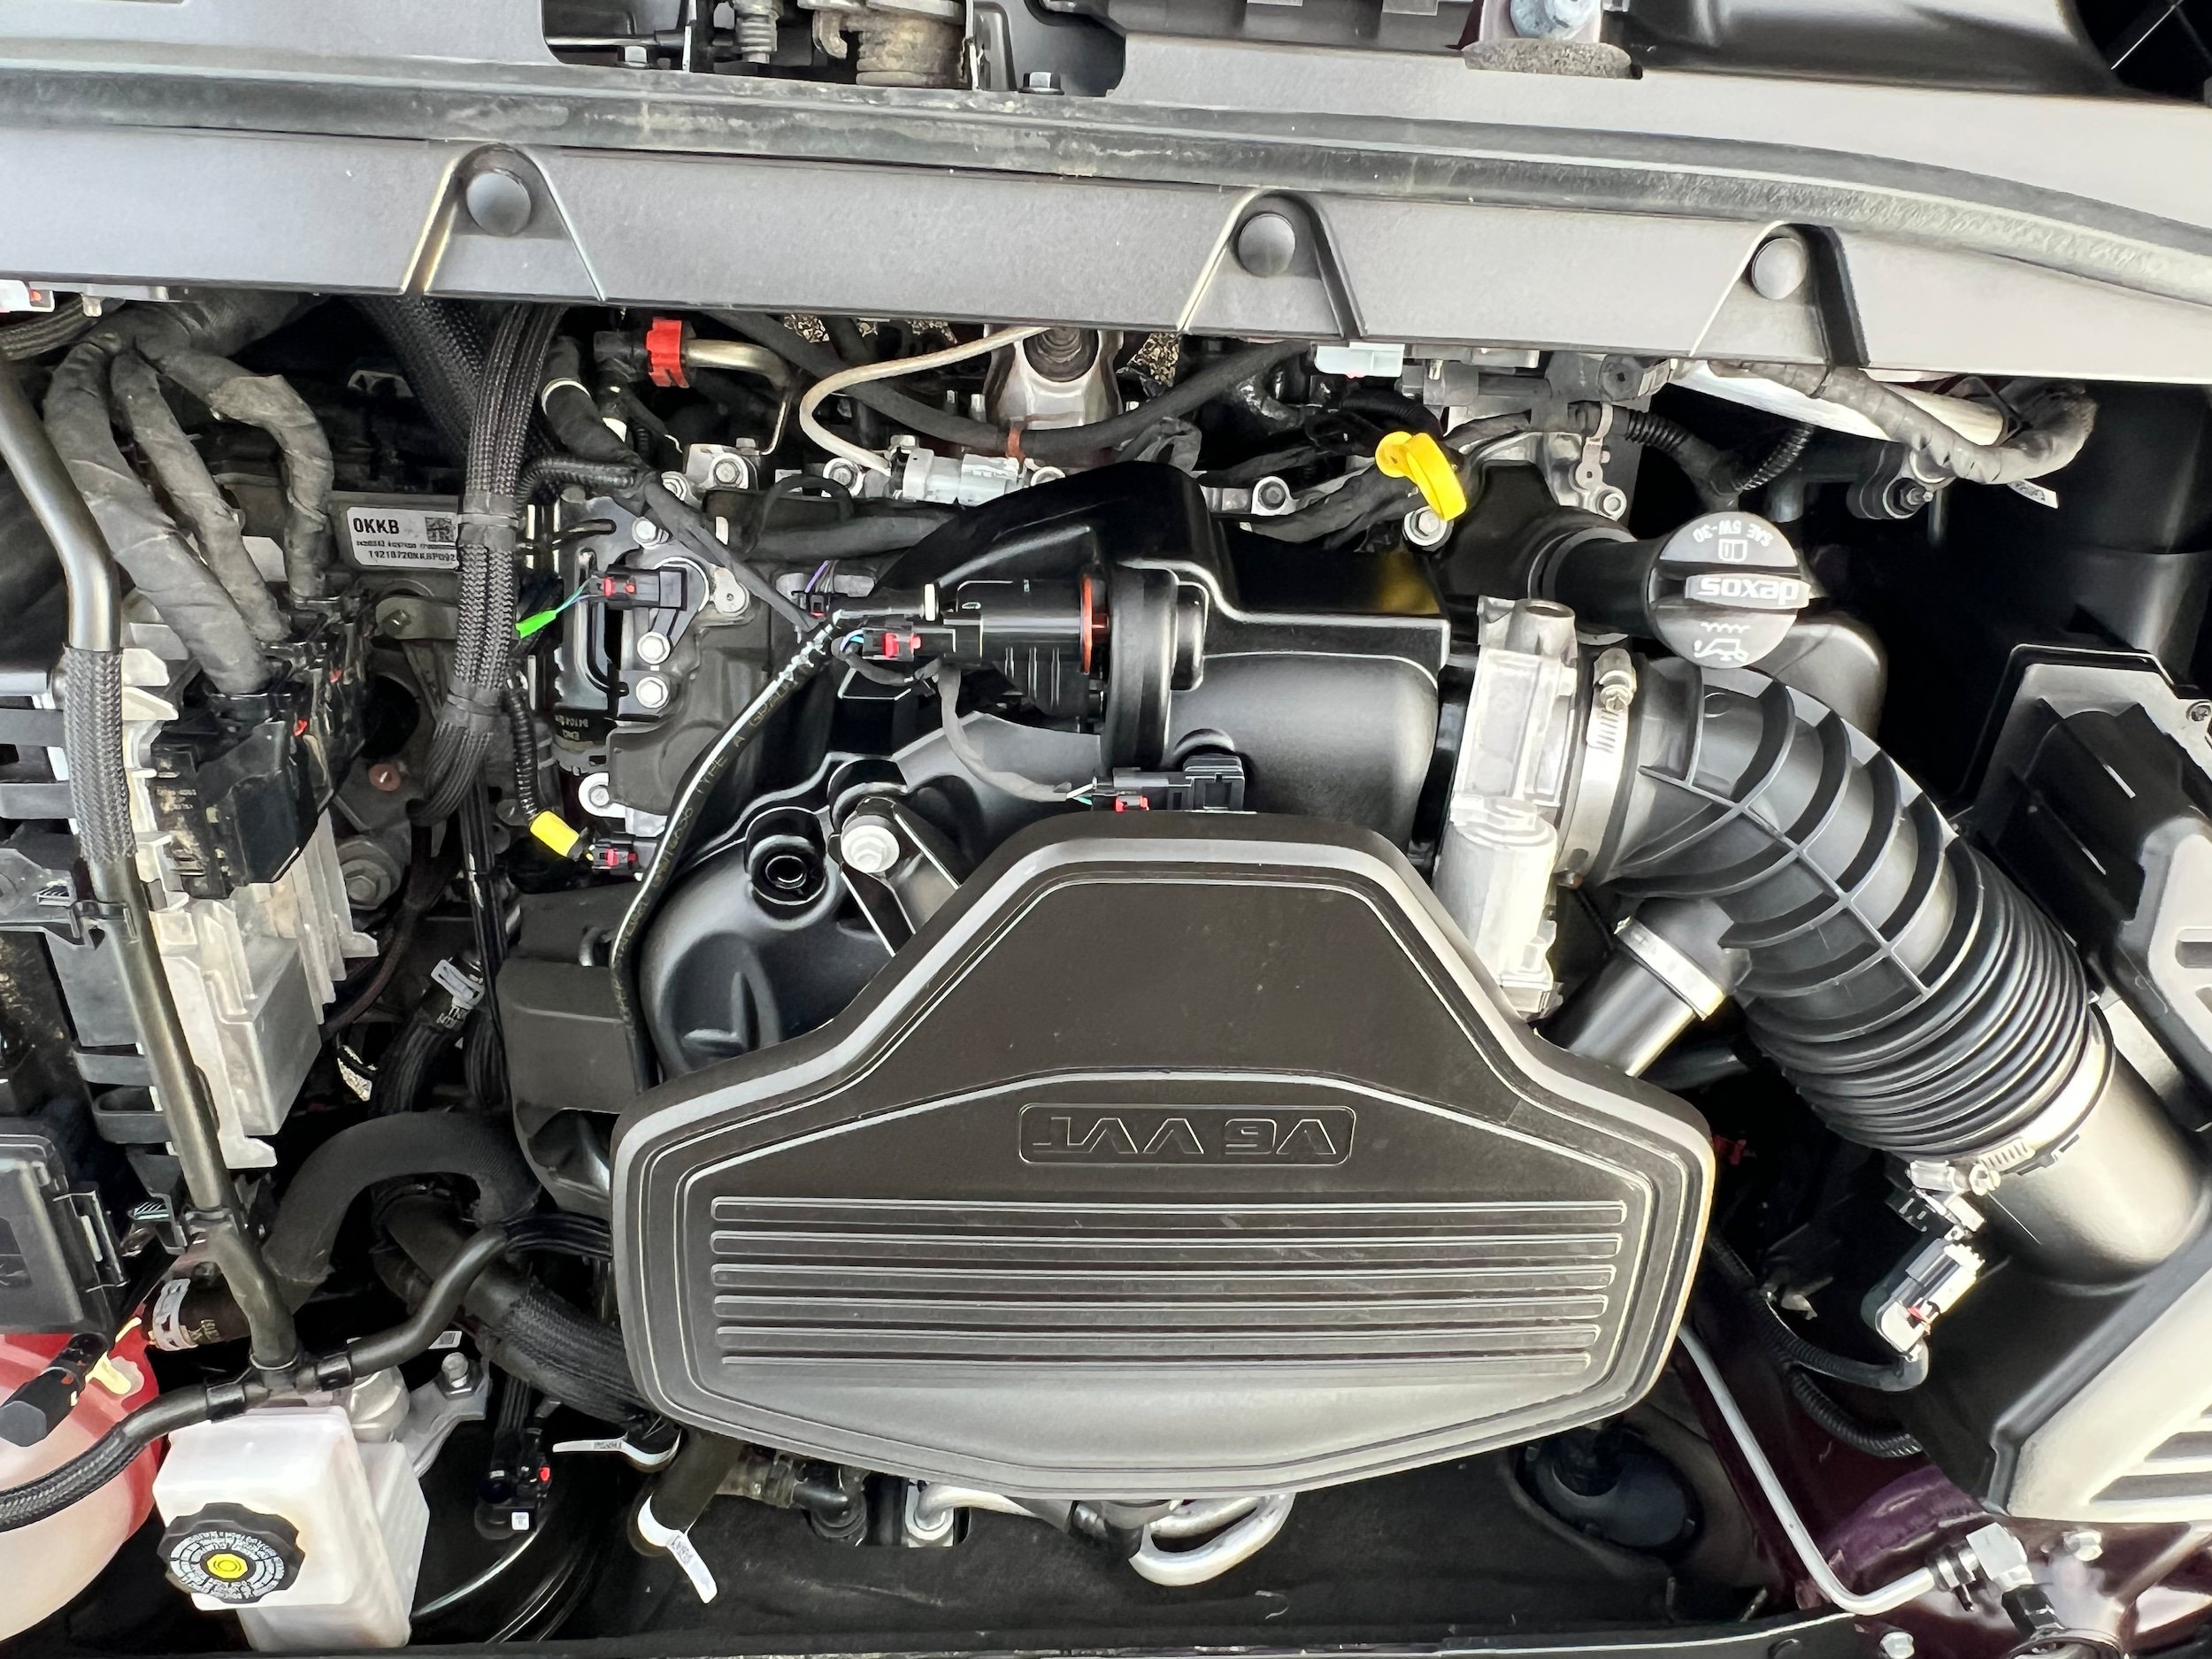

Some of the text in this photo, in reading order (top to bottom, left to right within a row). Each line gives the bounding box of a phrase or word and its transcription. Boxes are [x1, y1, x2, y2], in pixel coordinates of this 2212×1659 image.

[1693, 519, 1774, 547] SAE 5W-30
[1697, 577, 1800, 605] dexos
[1032, 1117, 1337, 1156] V6 VVT
